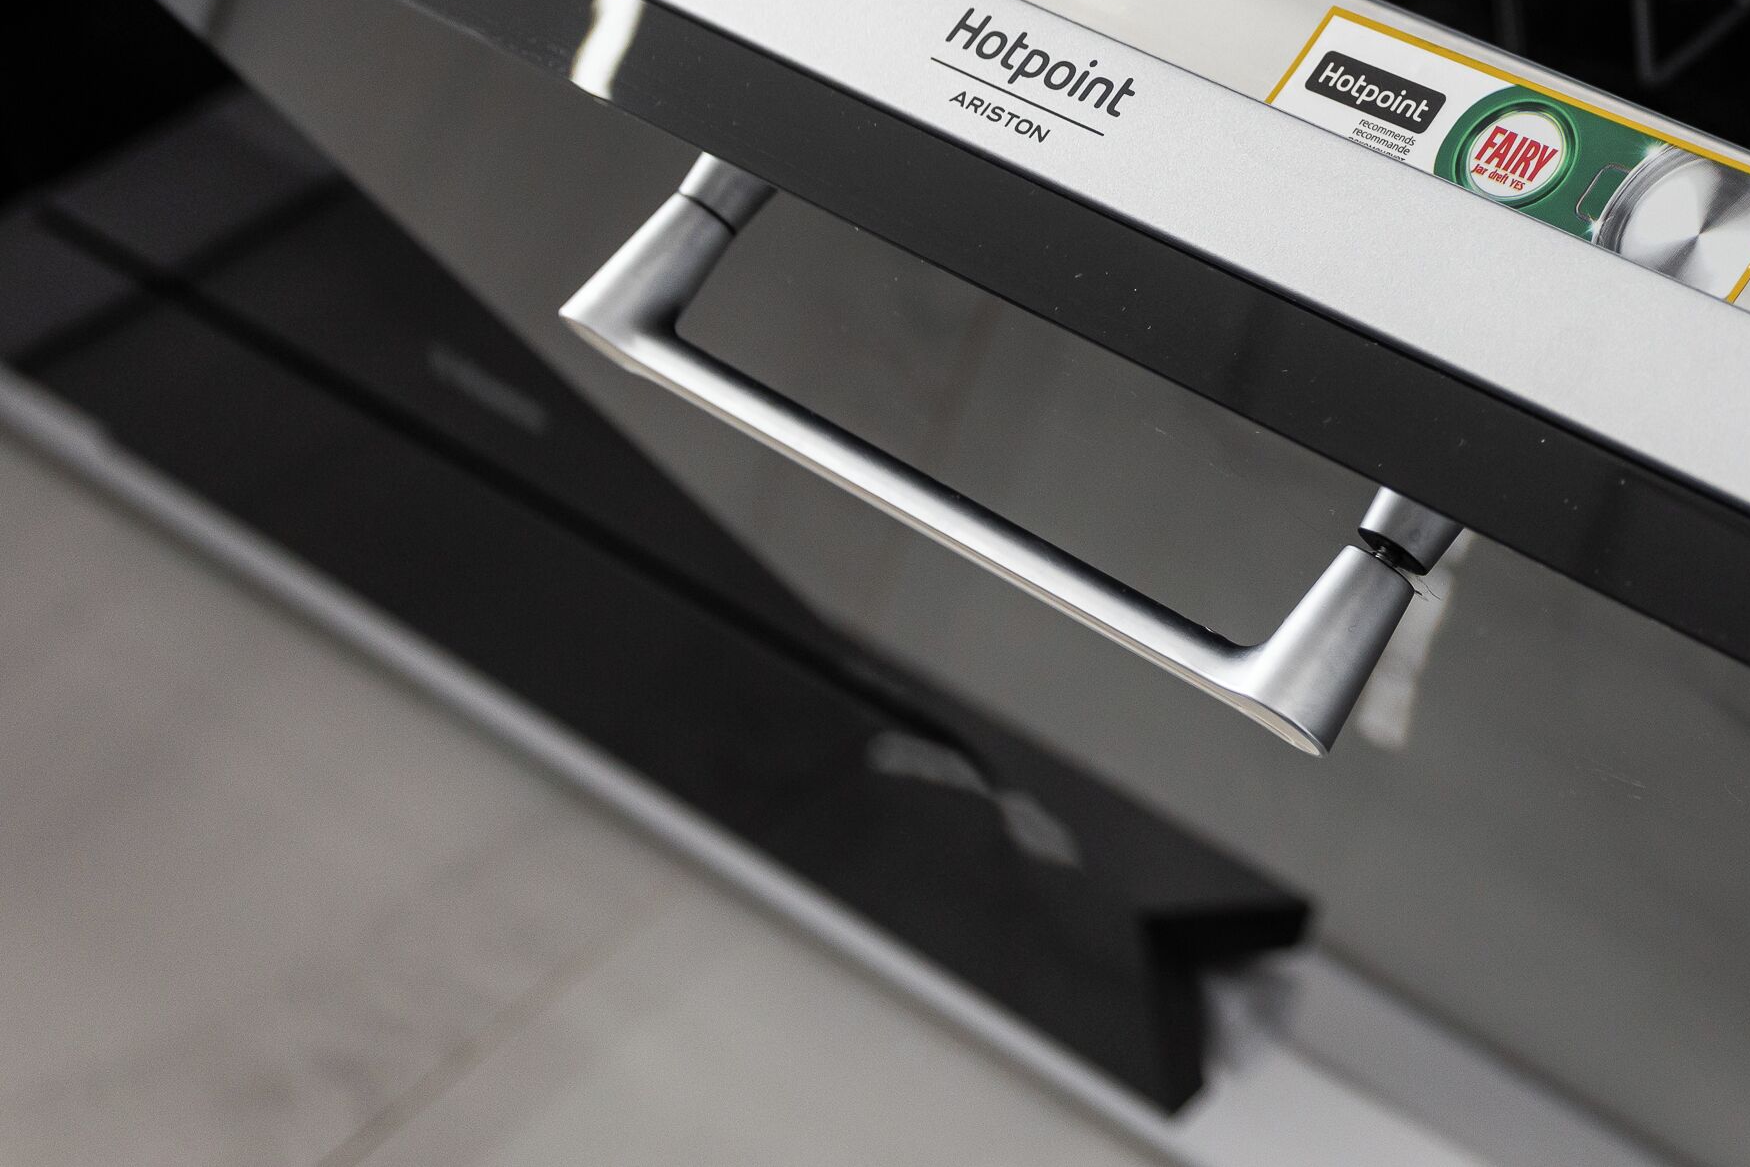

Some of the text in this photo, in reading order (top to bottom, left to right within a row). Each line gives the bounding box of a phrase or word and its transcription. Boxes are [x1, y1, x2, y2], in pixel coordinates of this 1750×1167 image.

[945, 7, 1135, 118] Hotpoint
[949, 90, 1051, 143] ARISTON
[1318, 62, 1429, 123] Hotpoint
[1352, 127, 1411, 156] recommande
[1358, 118, 1417, 147] recommends
[1475, 125, 1559, 183] FAIRY
[1471, 163, 1526, 191] Jar dreft YES
